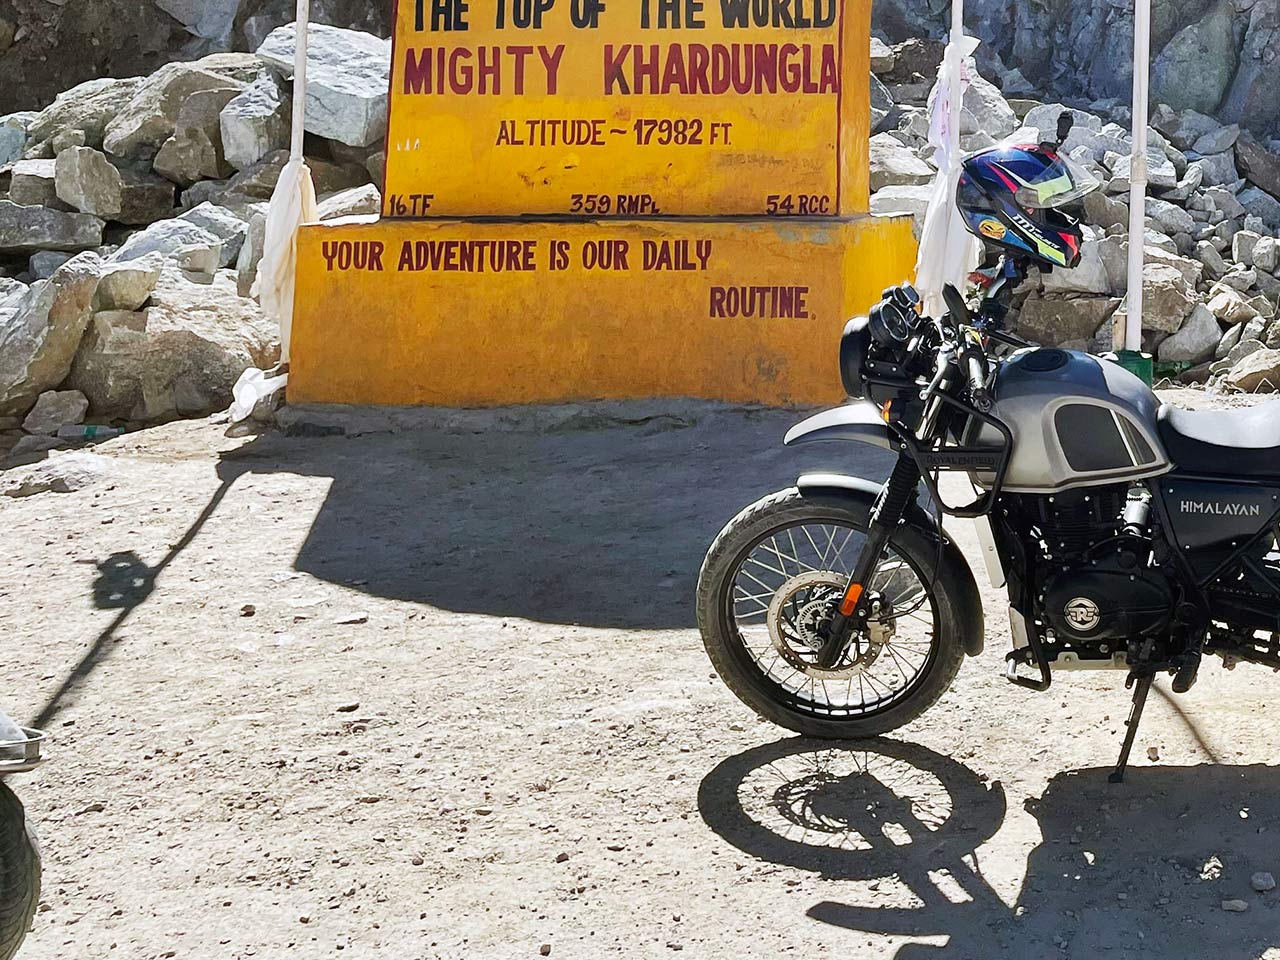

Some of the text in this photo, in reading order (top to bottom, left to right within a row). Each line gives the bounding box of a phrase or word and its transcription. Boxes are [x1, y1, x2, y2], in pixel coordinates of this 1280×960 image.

[404, 44, 837, 95] MIGHTY KHARDUNGLA
[390, 194, 434, 215] 16 TF
[569, 194, 611, 213] 359
[766, 194, 829, 215] 54 RCC
[322, 240, 712, 272] YOUR ADVENTURE IS OUR DAILY
[1181, 501, 1260, 515] HIMALAYAN
